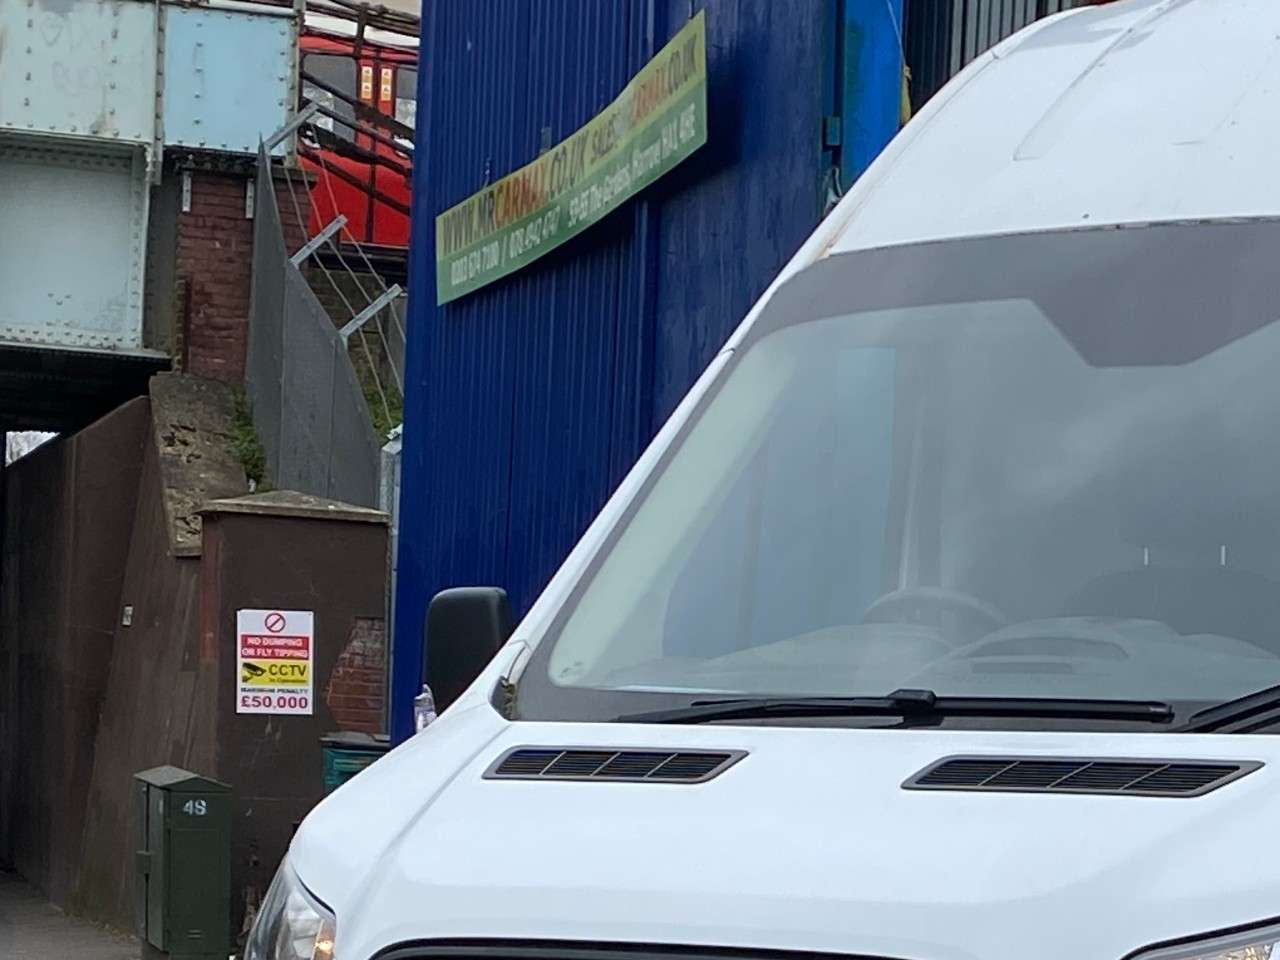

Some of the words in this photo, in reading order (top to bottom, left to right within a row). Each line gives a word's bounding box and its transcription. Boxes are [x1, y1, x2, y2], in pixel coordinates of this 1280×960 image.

[247, 637, 261, 646] NO
[262, 638, 303, 647] DUMPING
[242, 648, 256, 656] OR
[257, 648, 272, 657] FLY
[274, 649, 308, 658] TIPPING
[269, 664, 307, 677] CCTV
